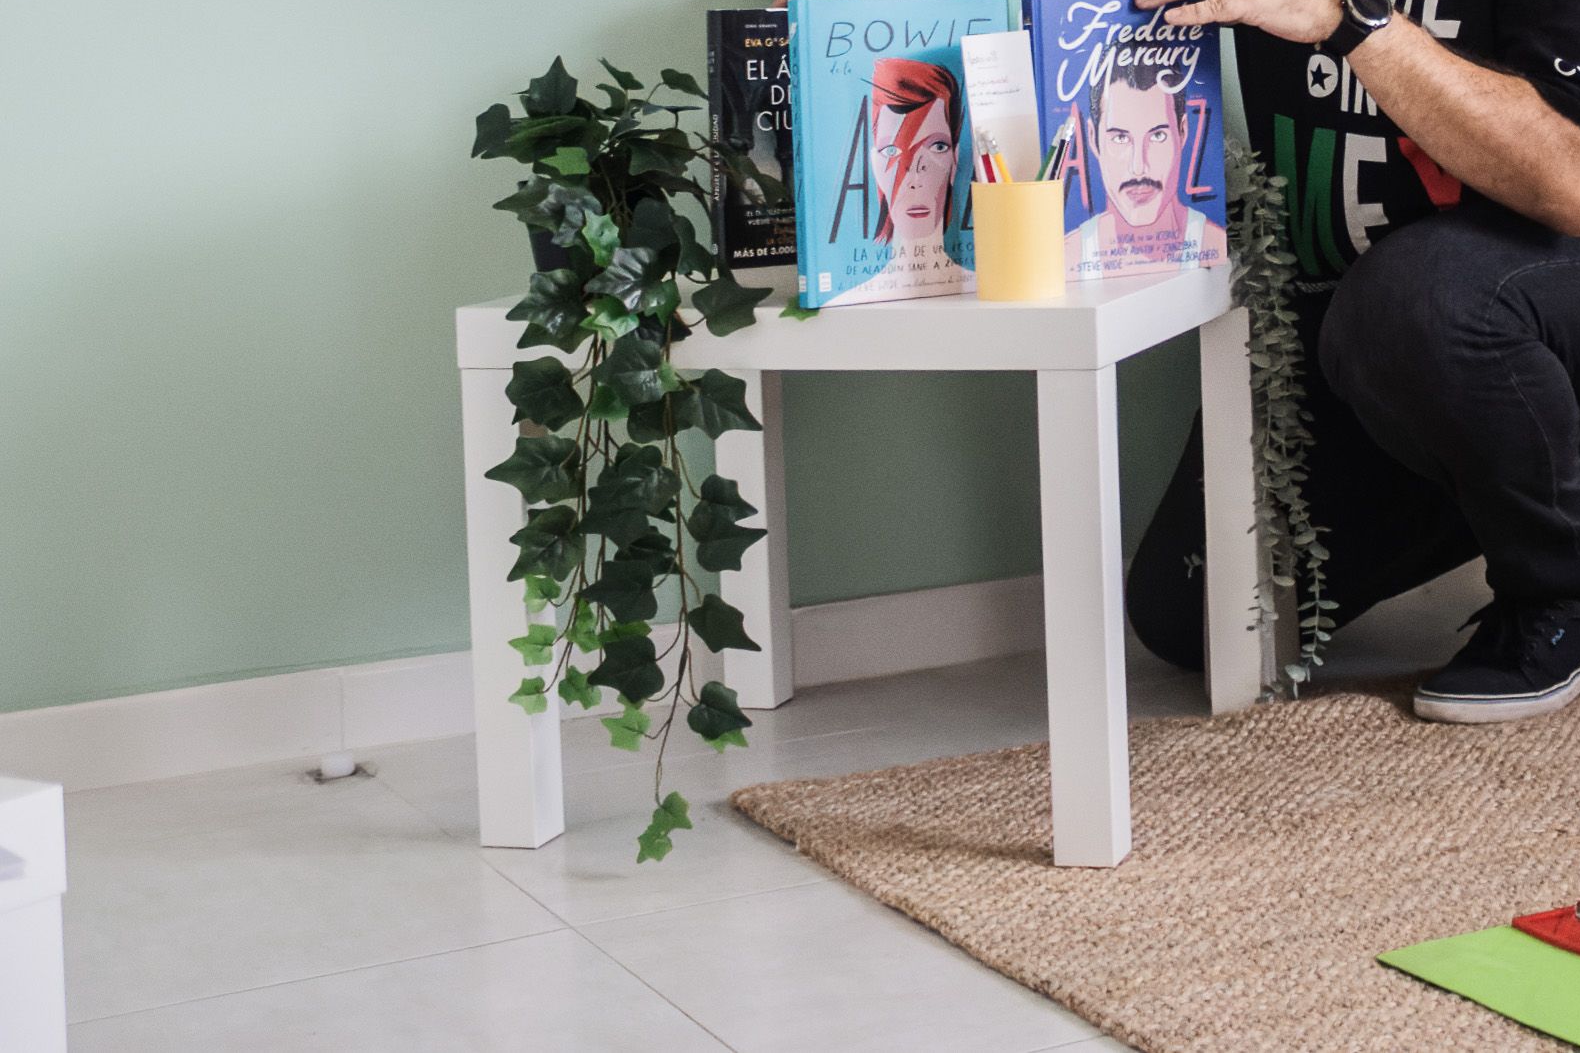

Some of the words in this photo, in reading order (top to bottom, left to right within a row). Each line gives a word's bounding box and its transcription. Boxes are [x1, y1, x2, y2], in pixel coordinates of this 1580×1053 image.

[744, 38, 763, 48] EVA
[746, 59, 769, 81] EL
[1056, 42, 1200, 103] Mercury
[1185, 98, 1213, 195] Z
[827, 94, 870, 245] A
[733, 247, 755, 259] MÁS
[756, 247, 768, 256] DE
[853, 247, 868, 263] LA
[875, 248, 907, 261] VIDA
[913, 246, 926, 258] DE
